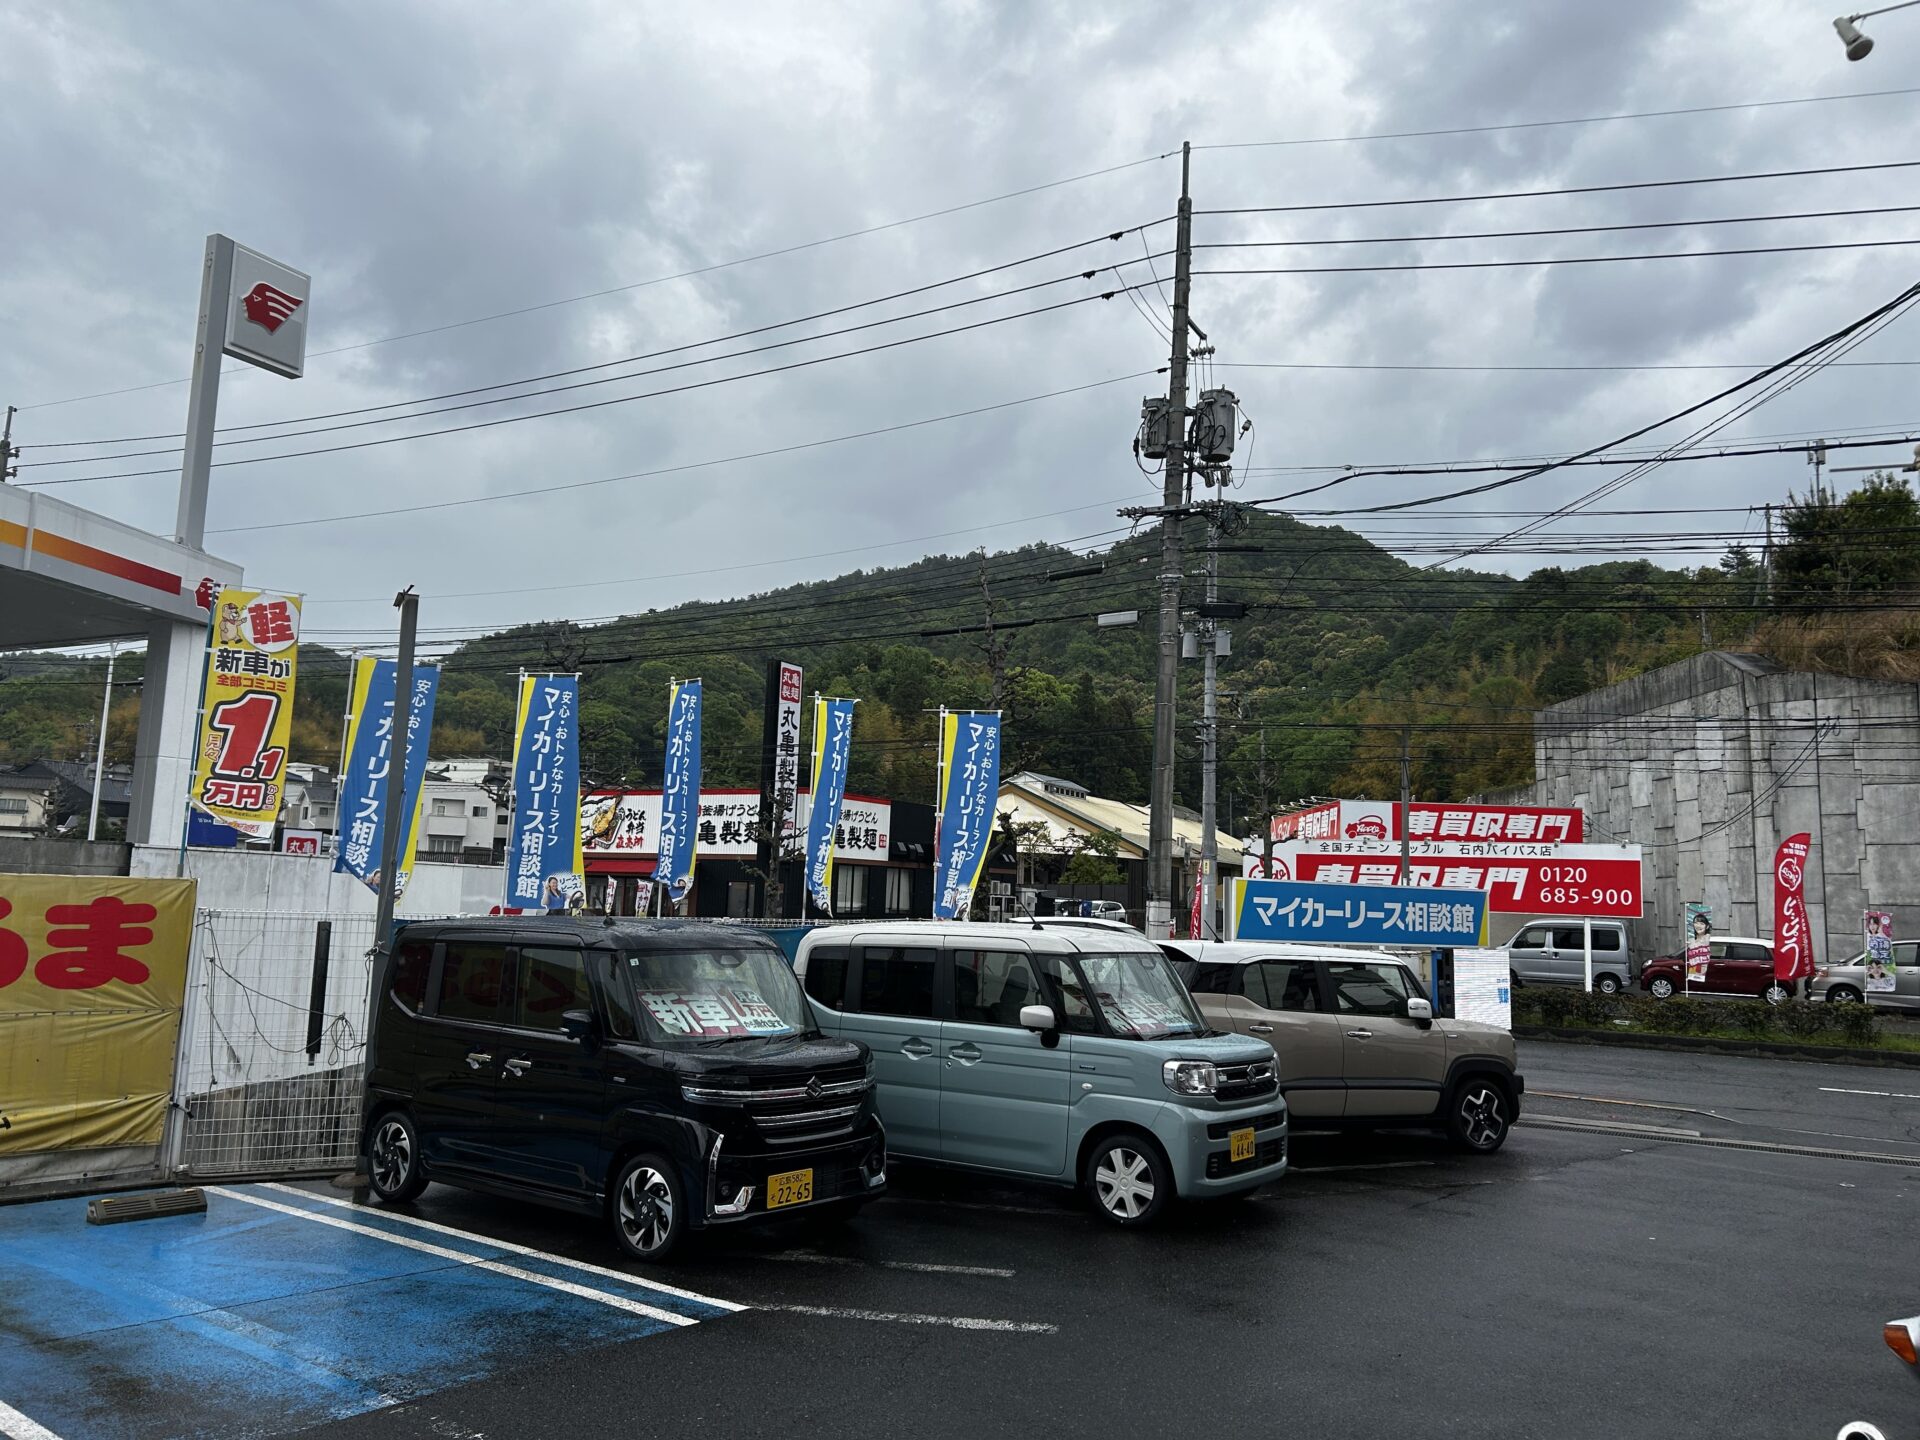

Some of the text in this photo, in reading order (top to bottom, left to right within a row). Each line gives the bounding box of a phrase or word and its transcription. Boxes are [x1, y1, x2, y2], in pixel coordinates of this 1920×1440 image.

[248, 601, 295, 644] 軽
[216, 648, 290, 678] 新車が
[216, 674, 287, 692] 全部コミコミ
[205, 734, 223, 762] 月々
[212, 692, 284, 779] 1.1
[547, 691, 573, 846] 安心・おトクなカーライフ
[679, 695, 697, 847] 安心・おトクなカーライフ
[777, 706, 798, 812] 丸亀製麺
[203, 780, 264, 809] 万円
[264, 785, 278, 805] から
[515, 687, 560, 899] マイカーリース相談館
[966, 727, 997, 860] 安心・おトクなカーライフ
[626, 808, 646, 820] うどん
[626, 821, 645, 834] 弁当
[1409, 811, 1571, 840] 車買取専門
[616, 834, 643, 849] 直売所
[1320, 842, 1390, 853] 全国チェーン
[1459, 844, 1552, 857] 石内バイパス店
[1540, 867, 1587, 883] 0120
[1540, 887, 1633, 905] 685-900
[1253, 896, 1474, 934] マイカーリース相談館
[641, 991, 740, 1033] 新車
[777, 1182, 811, 1205] 22-65
